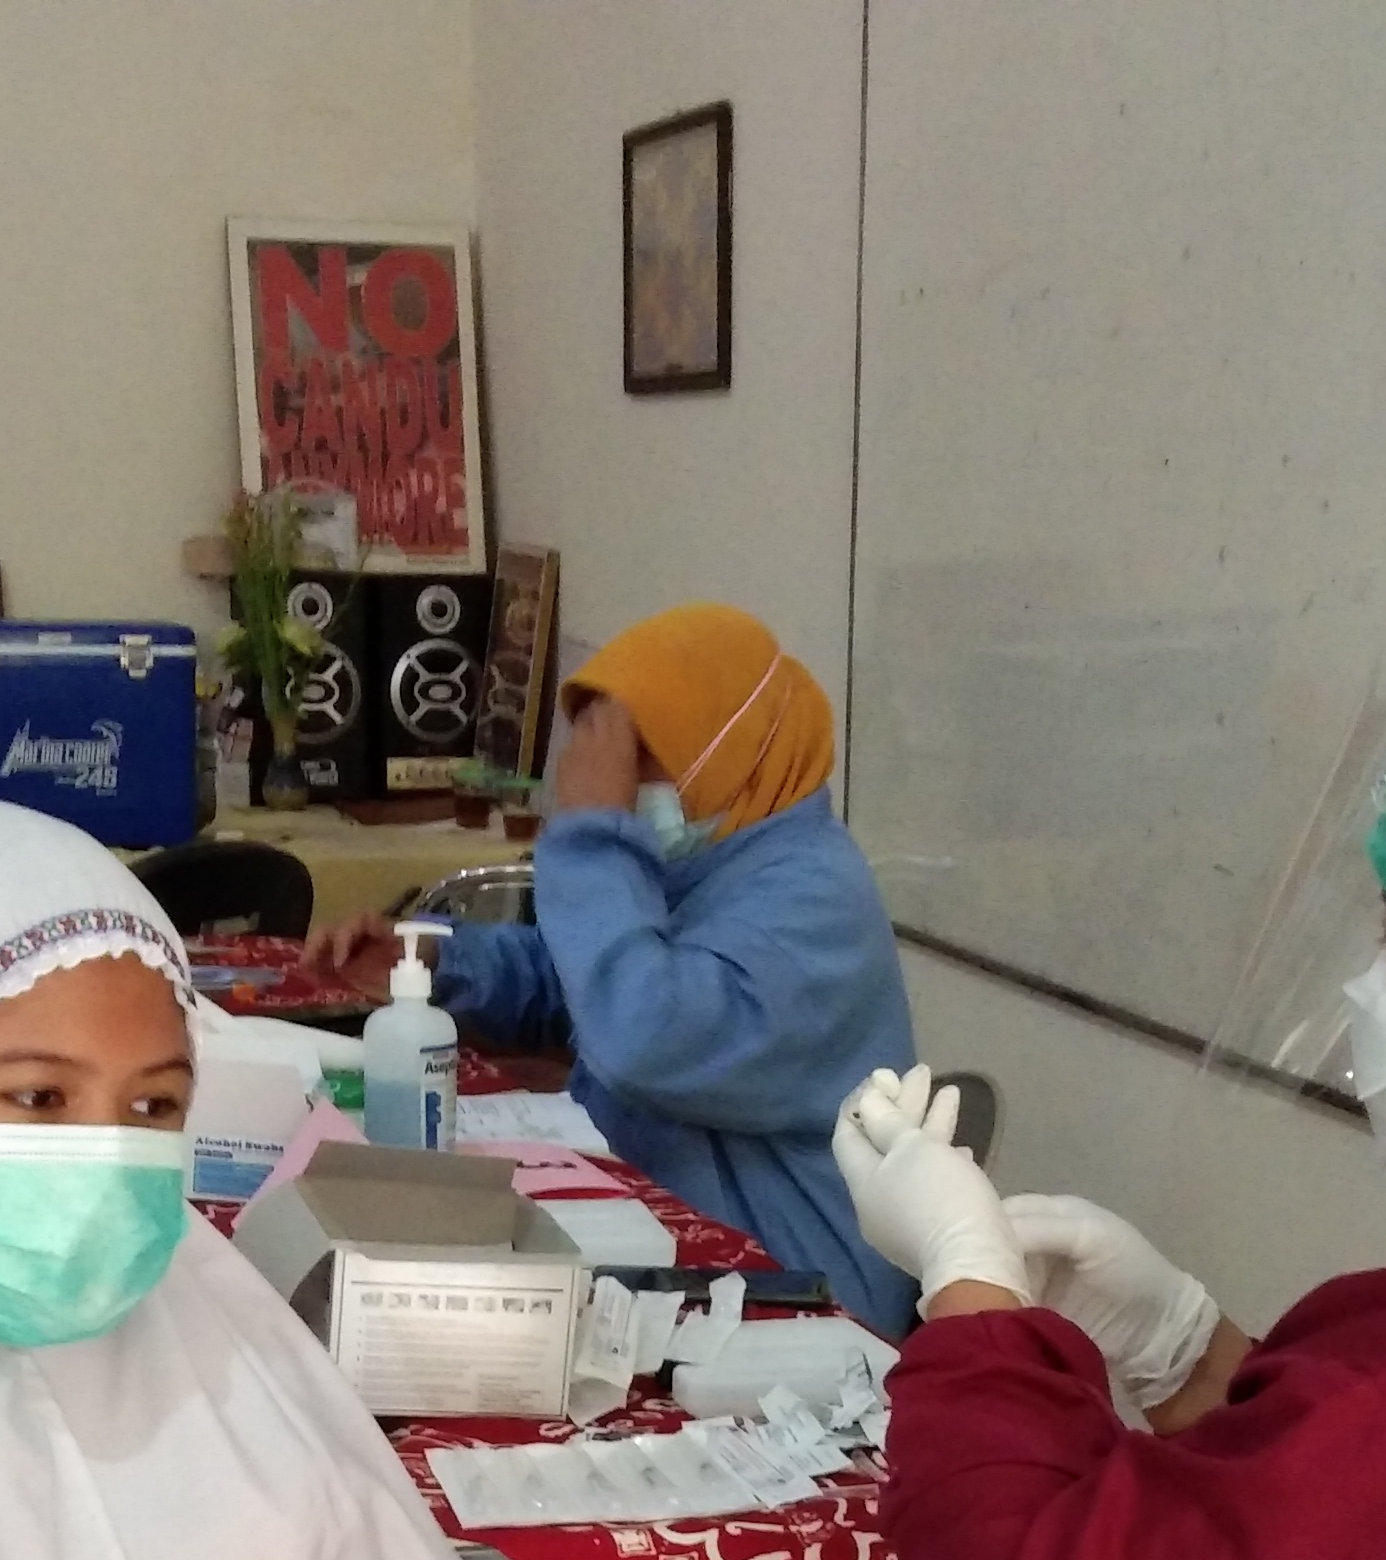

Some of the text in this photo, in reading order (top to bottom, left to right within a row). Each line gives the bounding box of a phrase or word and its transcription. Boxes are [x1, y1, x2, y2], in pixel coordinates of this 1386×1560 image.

[258, 246, 457, 356] NO
[259, 354, 465, 459] CANDU
[195, 1137, 243, 1150] Alcohol
